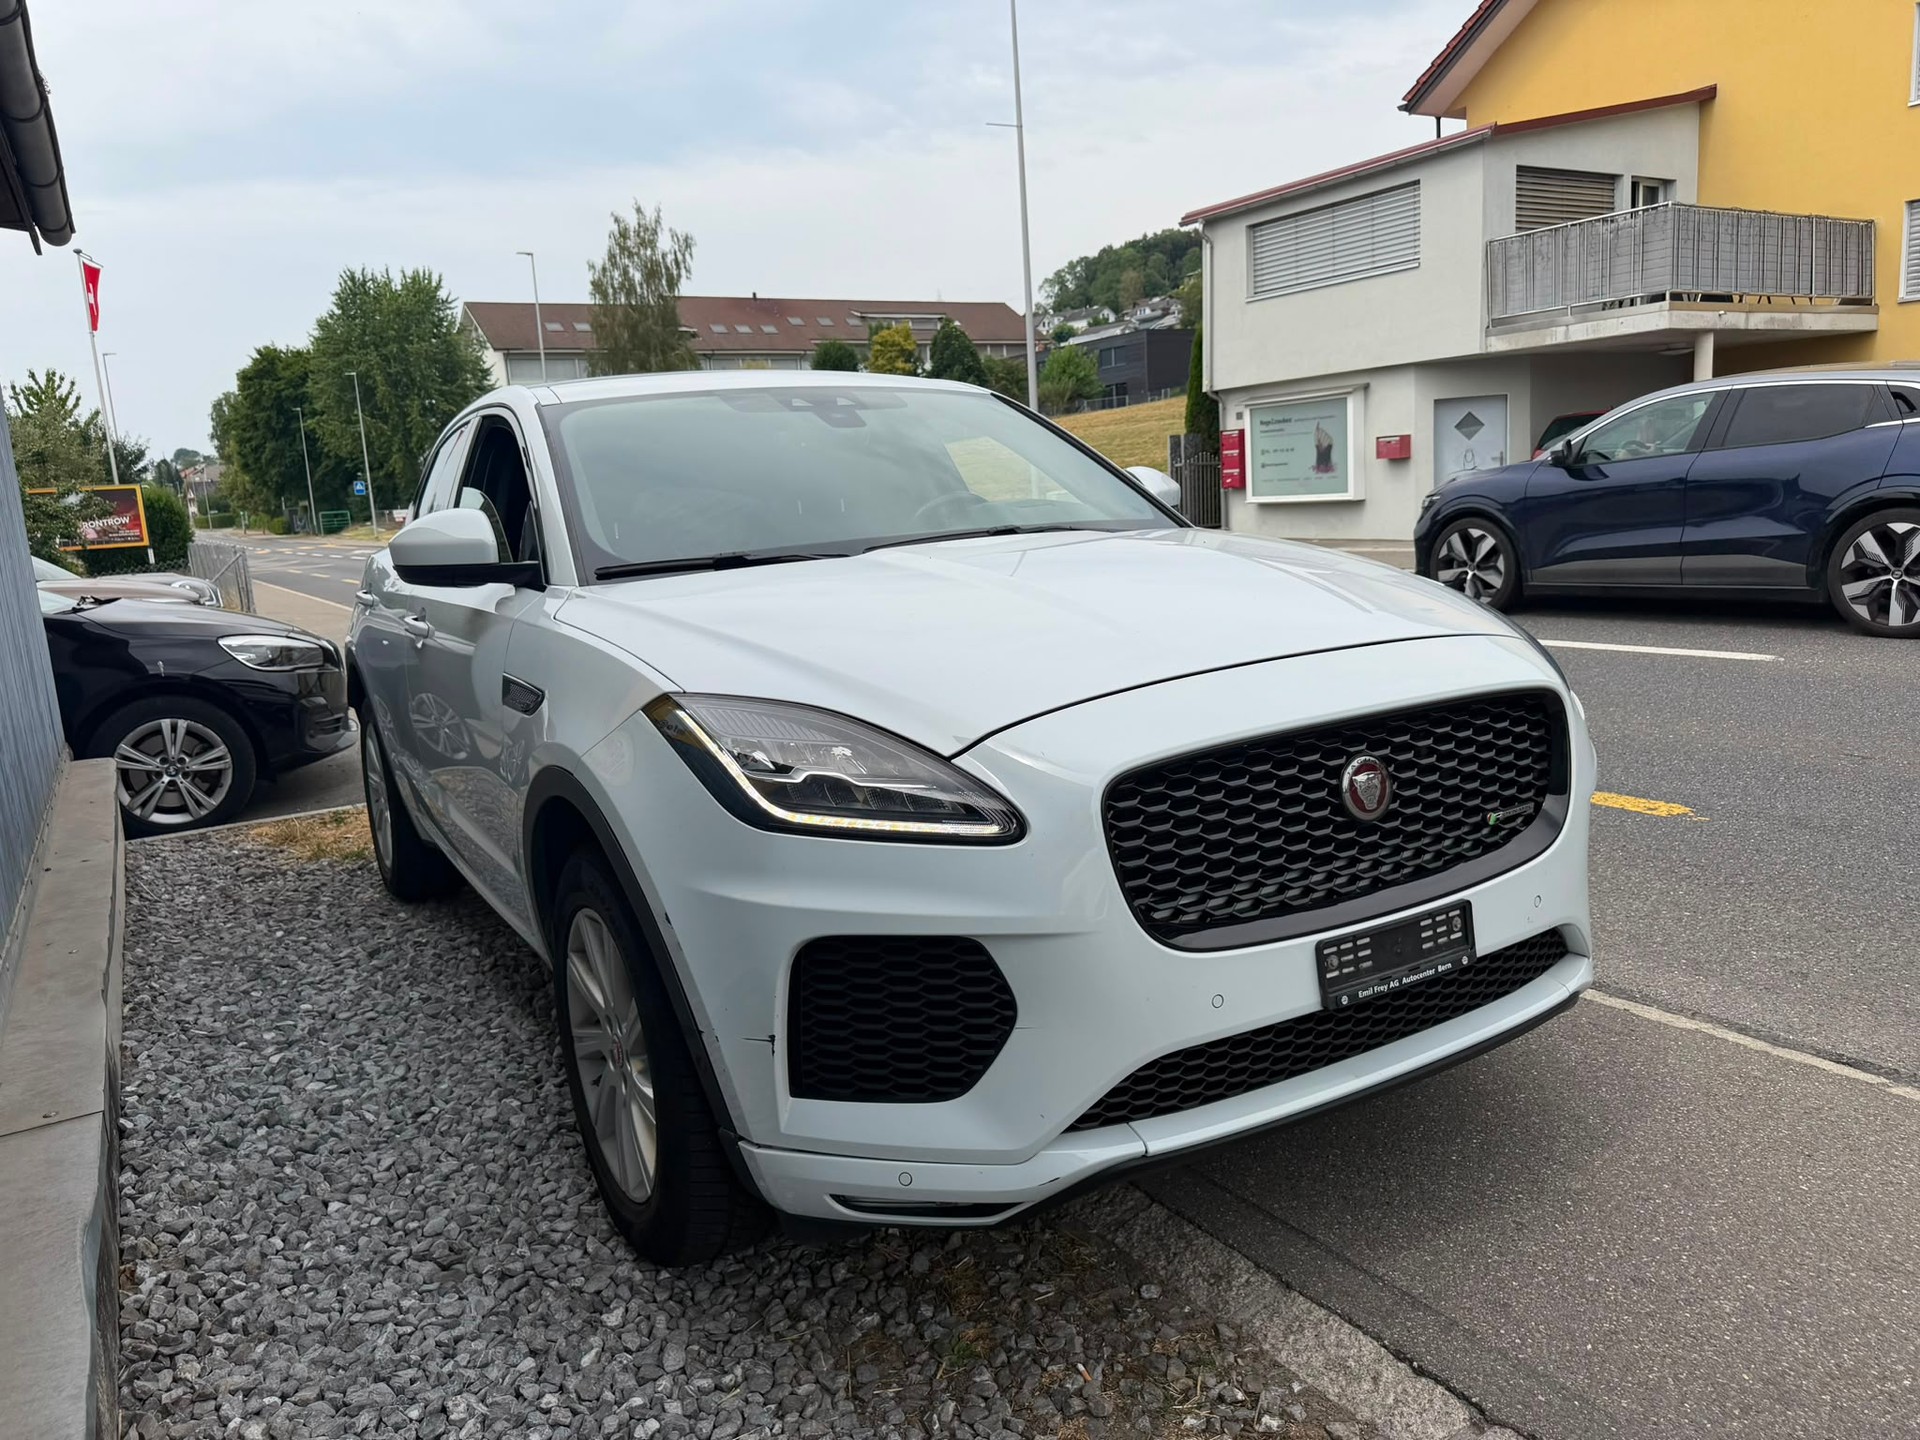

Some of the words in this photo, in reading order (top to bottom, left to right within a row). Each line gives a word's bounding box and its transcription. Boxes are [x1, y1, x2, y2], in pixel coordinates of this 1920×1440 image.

[82, 516, 130, 529] RONTROW
[1358, 986, 1373, 998] Emil
[1374, 982, 1389, 994] Frey
[1389, 979, 1399, 989] AG
[1402, 968, 1435, 984] Autocenter
[1438, 962, 1452, 973] Bern
